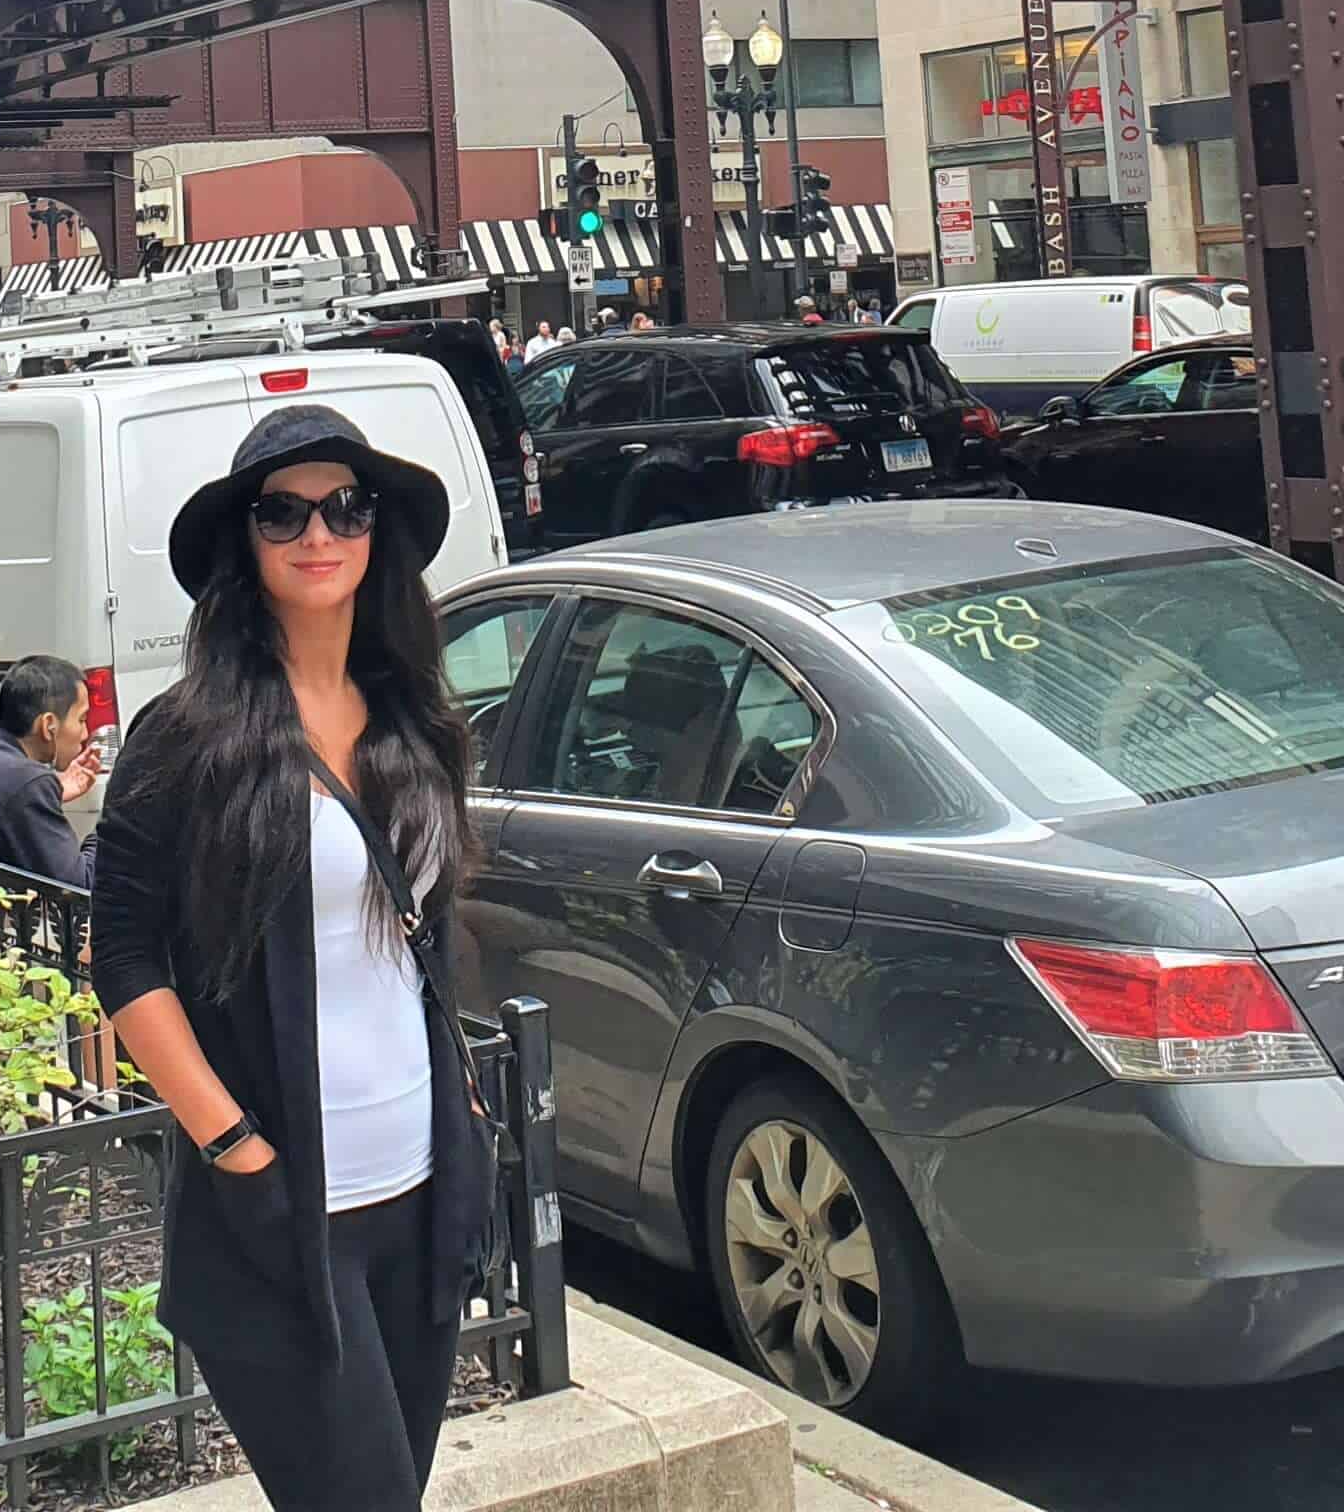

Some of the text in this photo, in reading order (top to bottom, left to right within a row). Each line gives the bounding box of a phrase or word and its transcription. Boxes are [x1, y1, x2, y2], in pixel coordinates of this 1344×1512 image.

[555, 169, 640, 189] cner
[634, 202, 658, 219] CA
[1042, 185, 1067, 276] BASH
[571, 250, 591, 261] ONE
[571, 263, 591, 273] WAY
[133, 634, 185, 652] NV20
[953, 622, 1040, 661] 76
